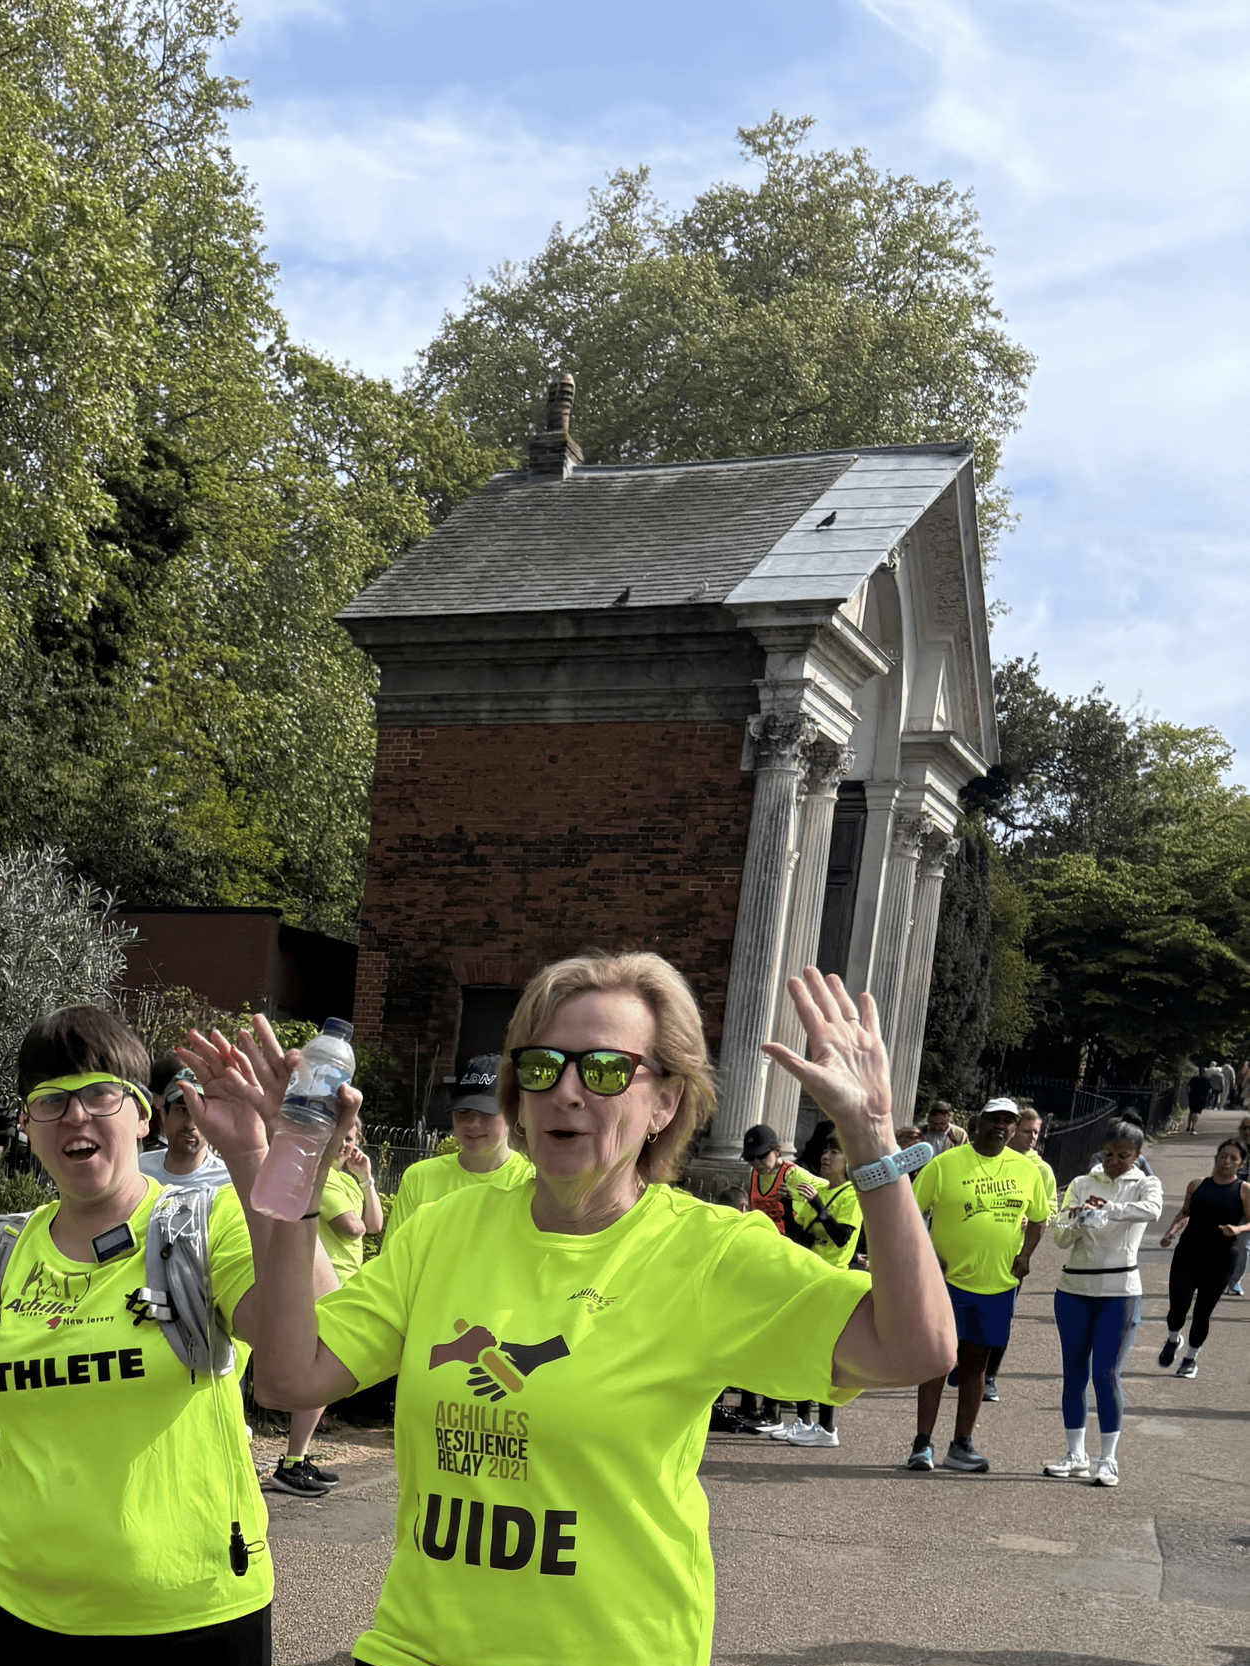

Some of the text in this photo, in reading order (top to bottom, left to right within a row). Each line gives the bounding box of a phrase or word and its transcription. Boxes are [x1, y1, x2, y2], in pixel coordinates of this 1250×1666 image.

[975, 1179, 1017, 1196] ACHILLES
[62, 1315, 115, 1326] New Jersey
[435, 1400, 529, 1438] ACHILLES
[435, 1427, 529, 1460] RESILIENCE
[437, 1448, 528, 1481] RELAY 2021
[414, 1492, 578, 1577] UIDE
